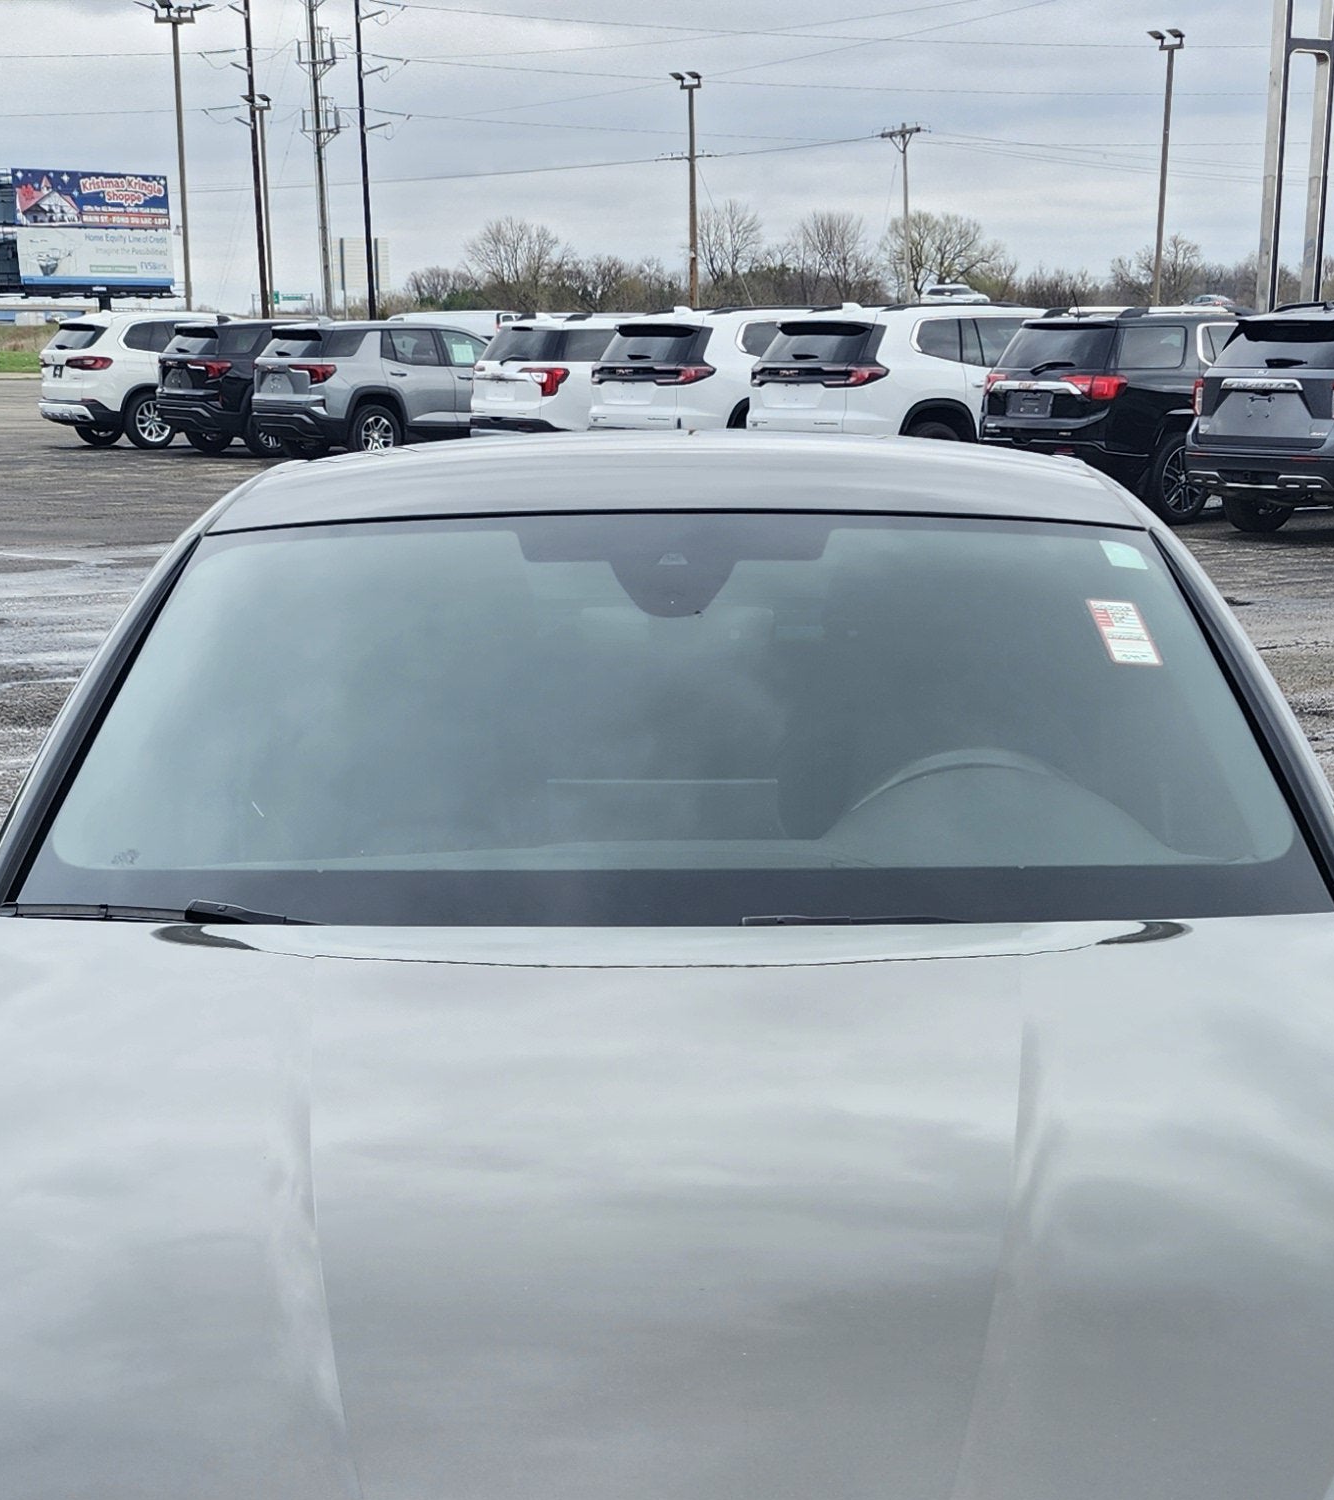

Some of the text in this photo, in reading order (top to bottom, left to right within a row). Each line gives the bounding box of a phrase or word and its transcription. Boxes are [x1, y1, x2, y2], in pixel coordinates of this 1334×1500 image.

[81, 178, 163, 195] Kristmas Kringle
[106, 191, 142, 204] Shoppe
[85, 233, 104, 241] Home
